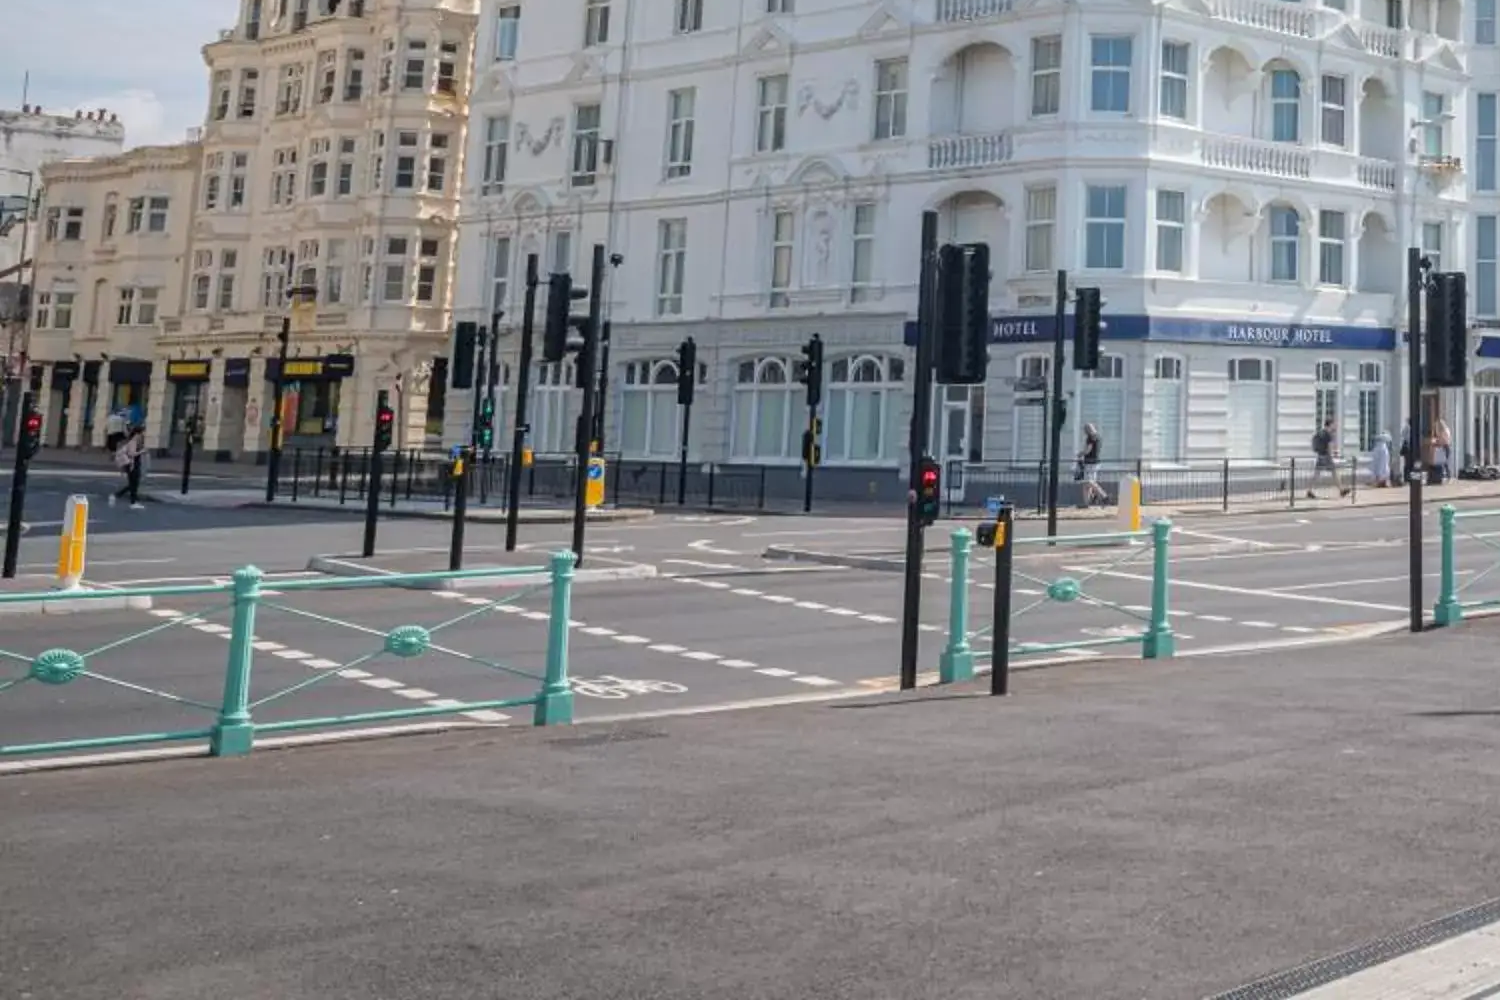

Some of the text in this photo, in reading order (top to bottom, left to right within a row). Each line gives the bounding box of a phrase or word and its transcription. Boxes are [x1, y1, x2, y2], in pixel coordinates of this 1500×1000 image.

[993, 321, 1037, 337] HOTEL
[1228, 326, 1332, 343] HARBOUR HOTEL
